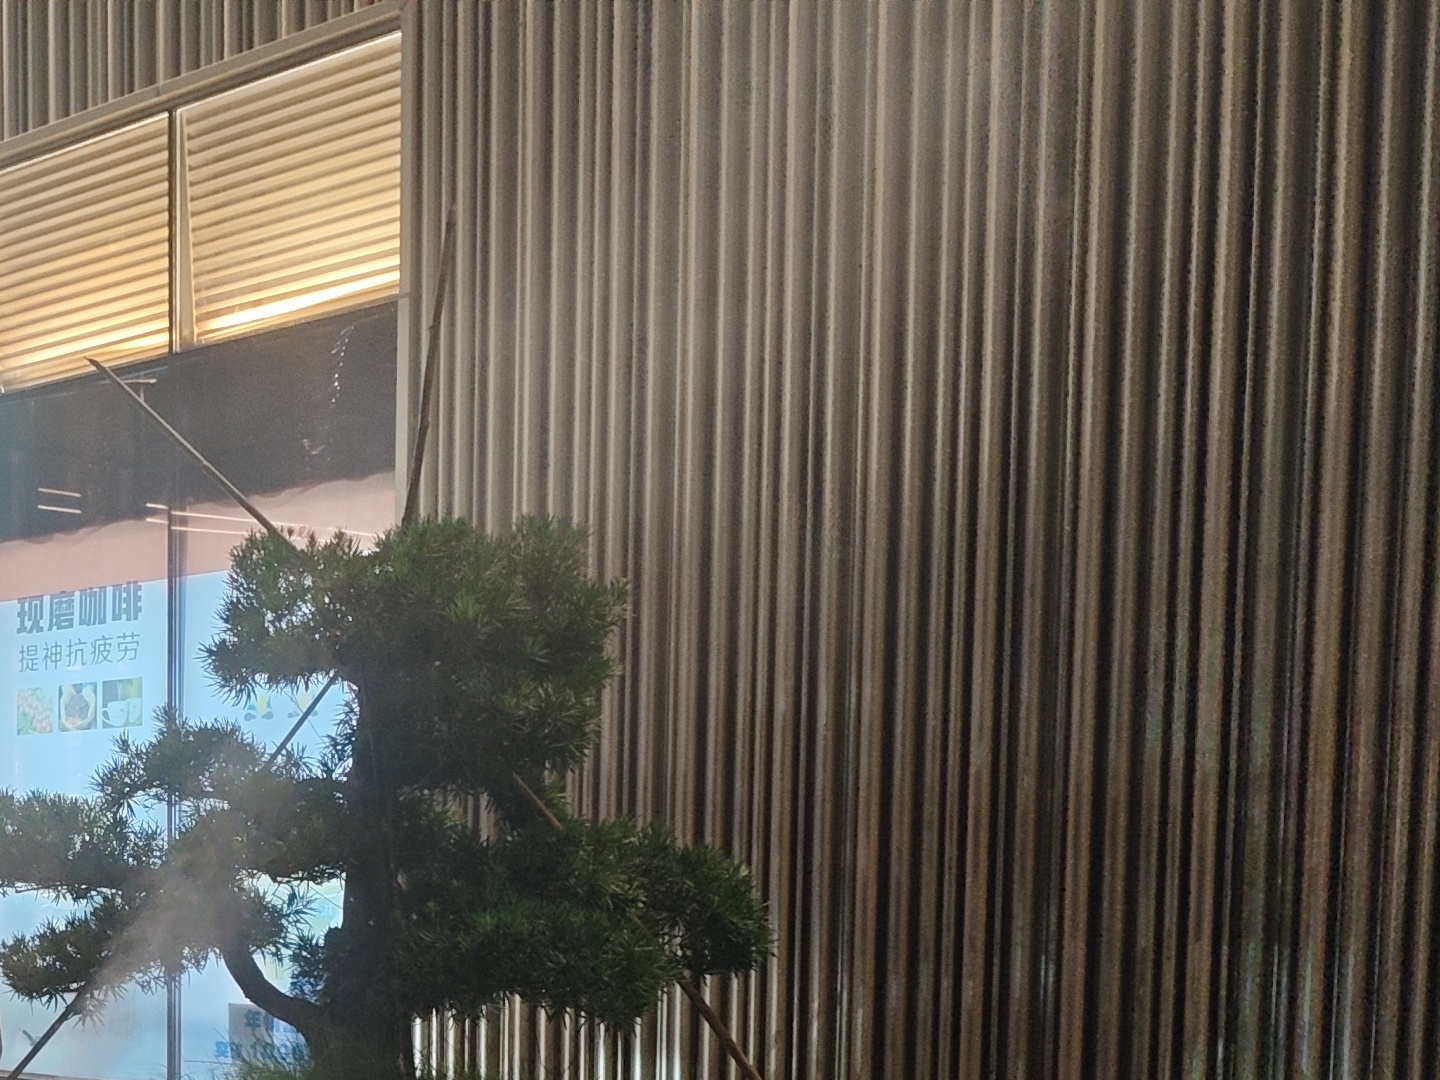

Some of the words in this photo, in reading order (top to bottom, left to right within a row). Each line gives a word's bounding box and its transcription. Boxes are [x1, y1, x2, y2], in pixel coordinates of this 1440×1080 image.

[16, 580, 142, 634] 现磨咖啡
[18, 631, 140, 673] 提神抗疲劳
